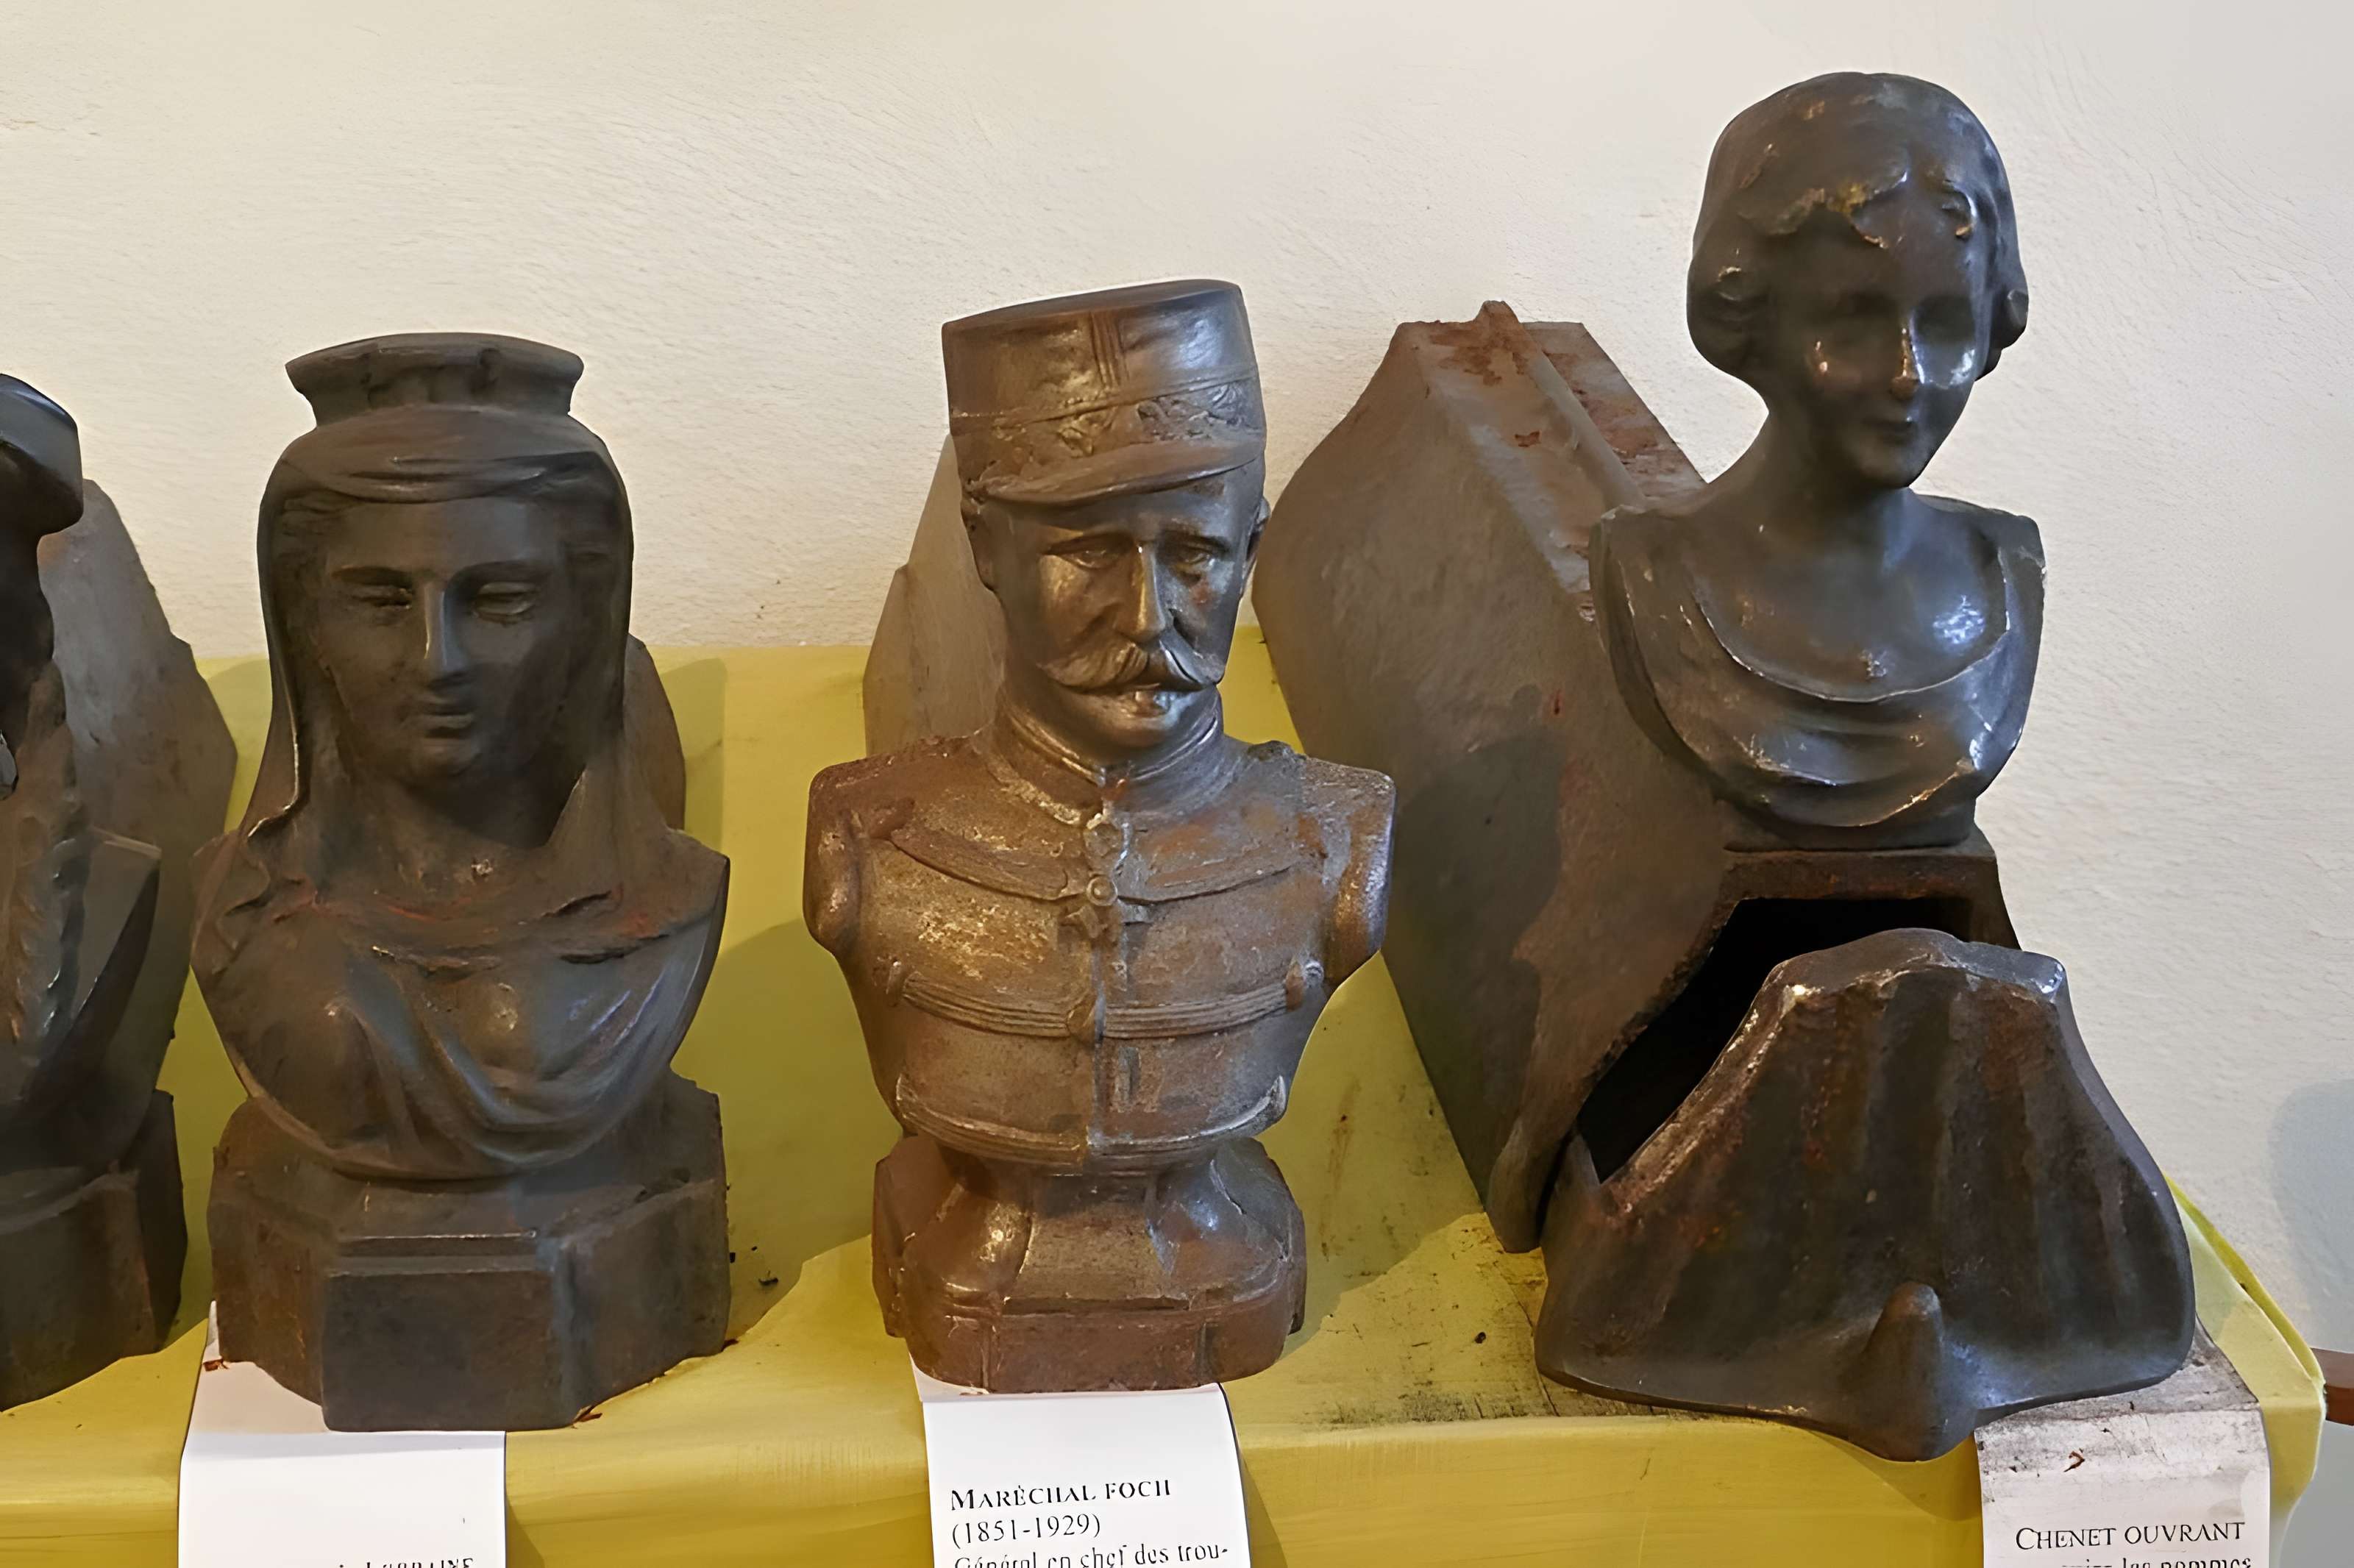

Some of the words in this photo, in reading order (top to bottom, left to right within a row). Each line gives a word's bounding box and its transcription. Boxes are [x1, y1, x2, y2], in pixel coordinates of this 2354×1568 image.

[1105, 1479, 1171, 1500] FOCH
[952, 1512, 1101, 1550] (1851-1929)
[2016, 1527, 2116, 1550] CHENET
[2124, 1521, 2246, 1545] OUVRANT
[1080, 1544, 1128, 1568] chef
[1134, 1542, 1170, 1565] des
[1177, 1544, 1228, 1562] trou-
